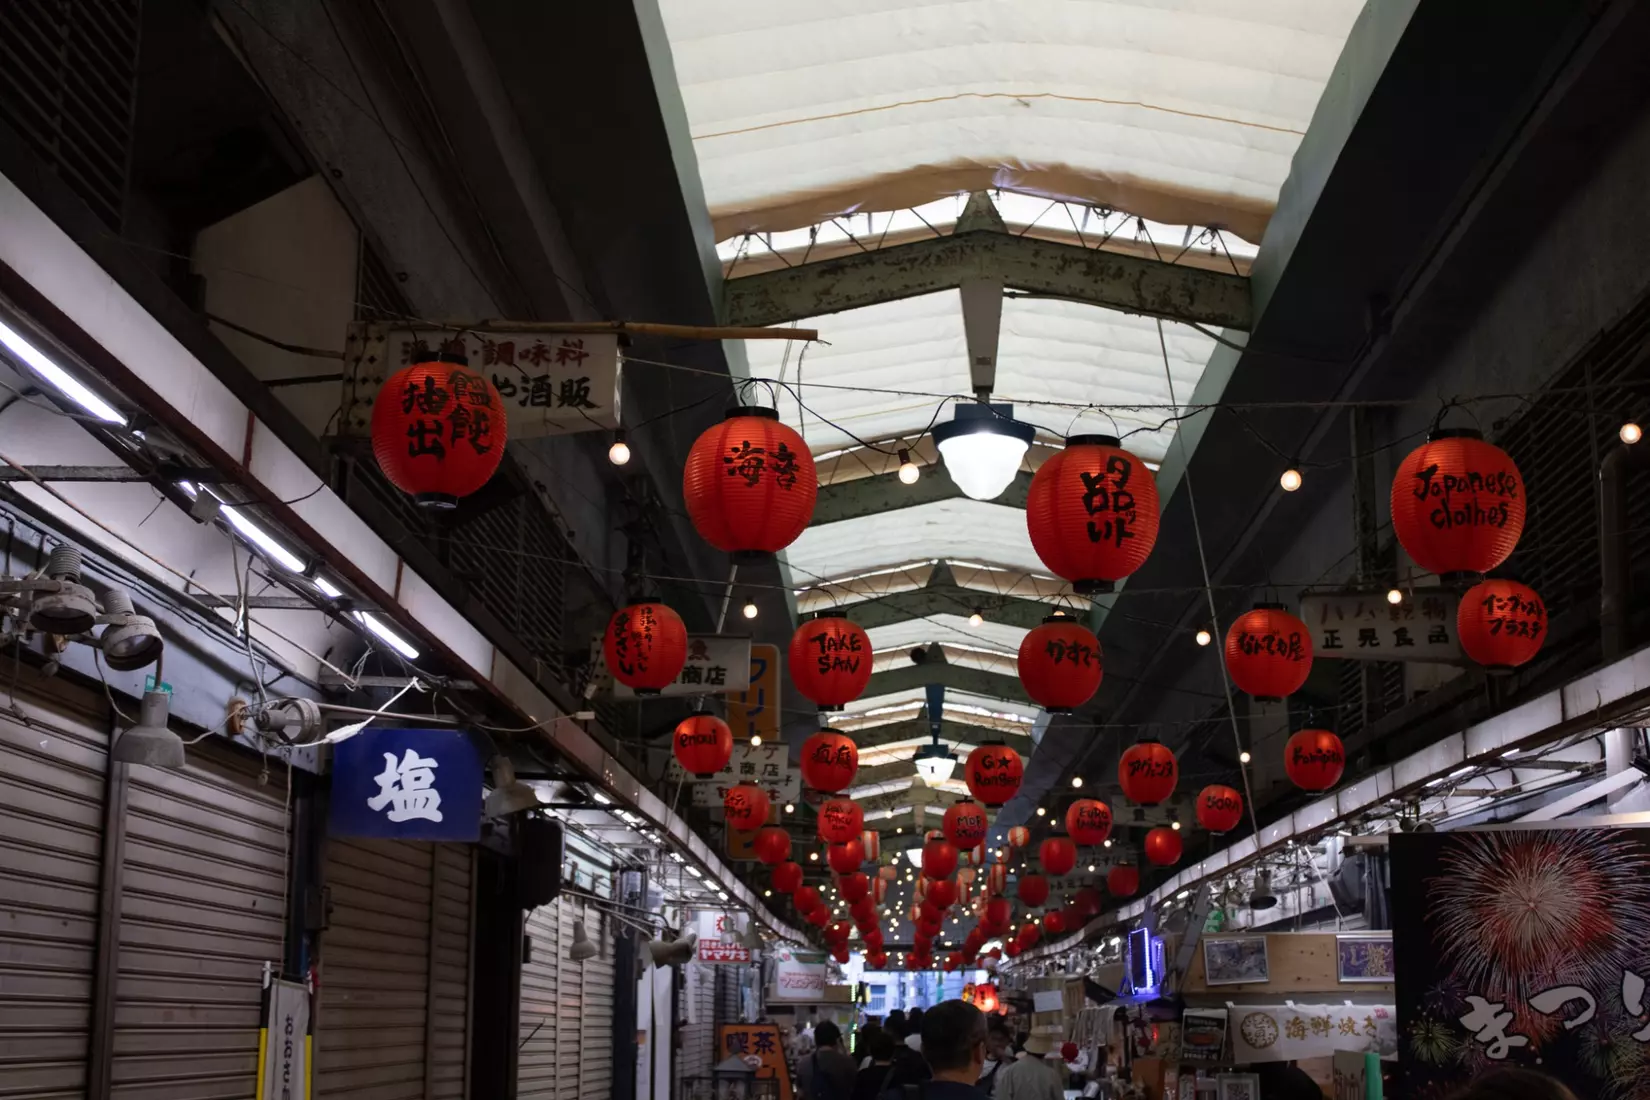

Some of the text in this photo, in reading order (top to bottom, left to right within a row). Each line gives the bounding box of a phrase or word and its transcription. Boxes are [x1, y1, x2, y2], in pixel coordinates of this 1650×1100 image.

[1413, 464, 1518, 501] Japanese
[1080, 472, 1112, 543] 占い
[1430, 499, 1509, 529] clothes
[810, 632, 862, 653] TAKE
[817, 655, 860, 675] SAN
[982, 755, 995, 770] G
[367, 748, 444, 823] 塩
[1284, 1014, 1378, 1041] 海鮮焼き
